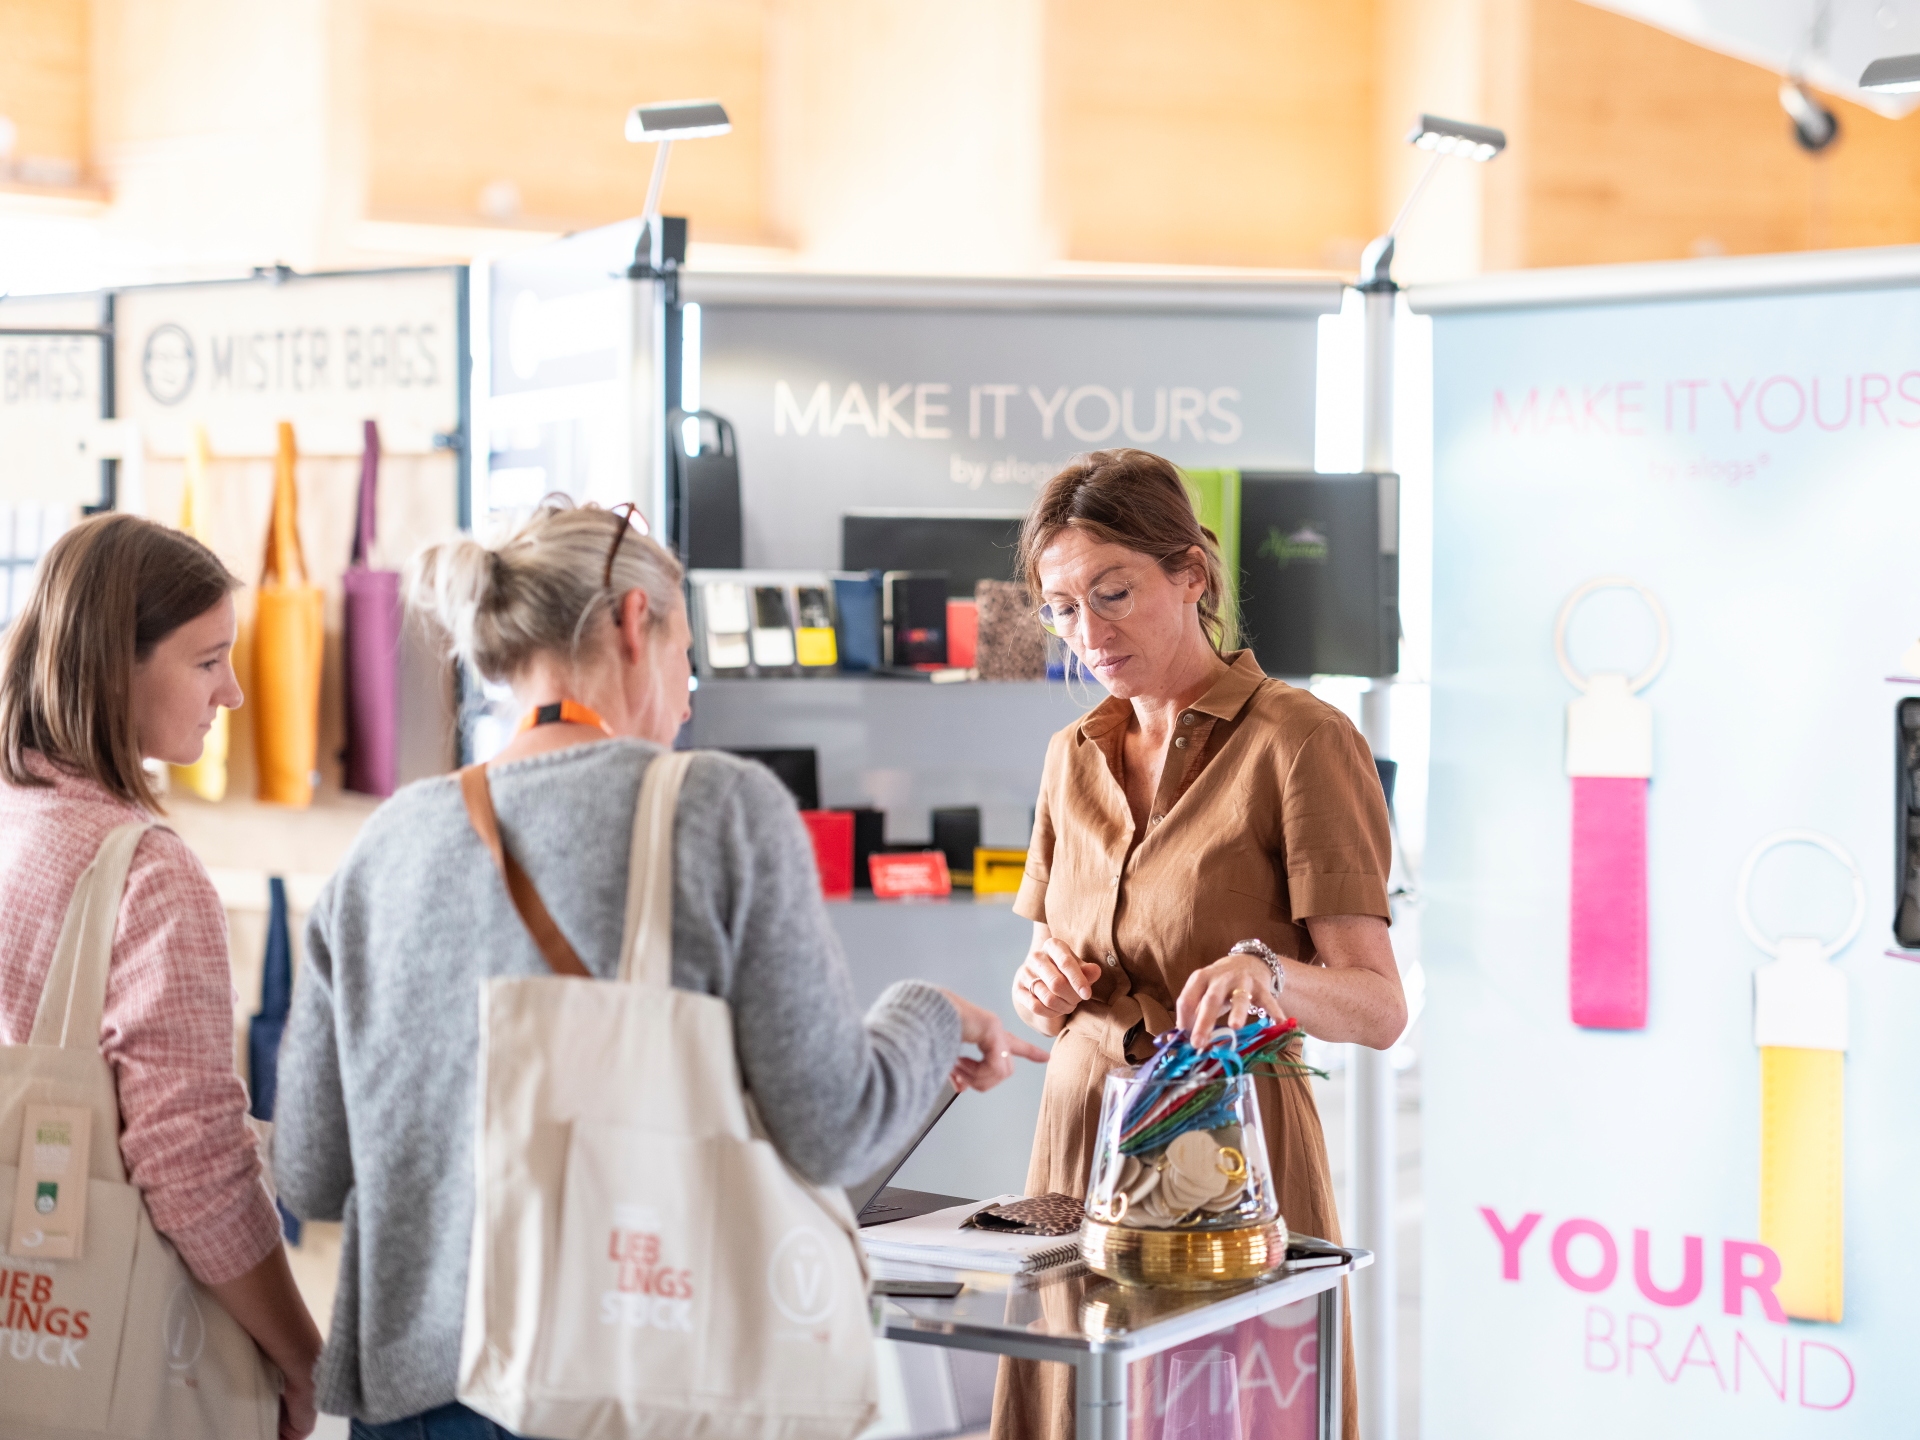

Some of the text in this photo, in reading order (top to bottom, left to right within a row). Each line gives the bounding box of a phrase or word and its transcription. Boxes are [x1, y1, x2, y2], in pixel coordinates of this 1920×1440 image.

[3, 344, 84, 403] BAGS
[210, 324, 441, 393] MISTER BAGS
[773, 381, 1243, 445] MAKE IT YOURS
[1492, 380, 1647, 437] MAKE
[1665, 378, 1710, 434] IT
[949, 453, 987, 490] by
[0, 1269, 54, 1305] IEB
[1478, 1204, 1790, 1326] YOUR
[0, 1299, 91, 1340] INGS
[1583, 1305, 1856, 1412] BRAND
